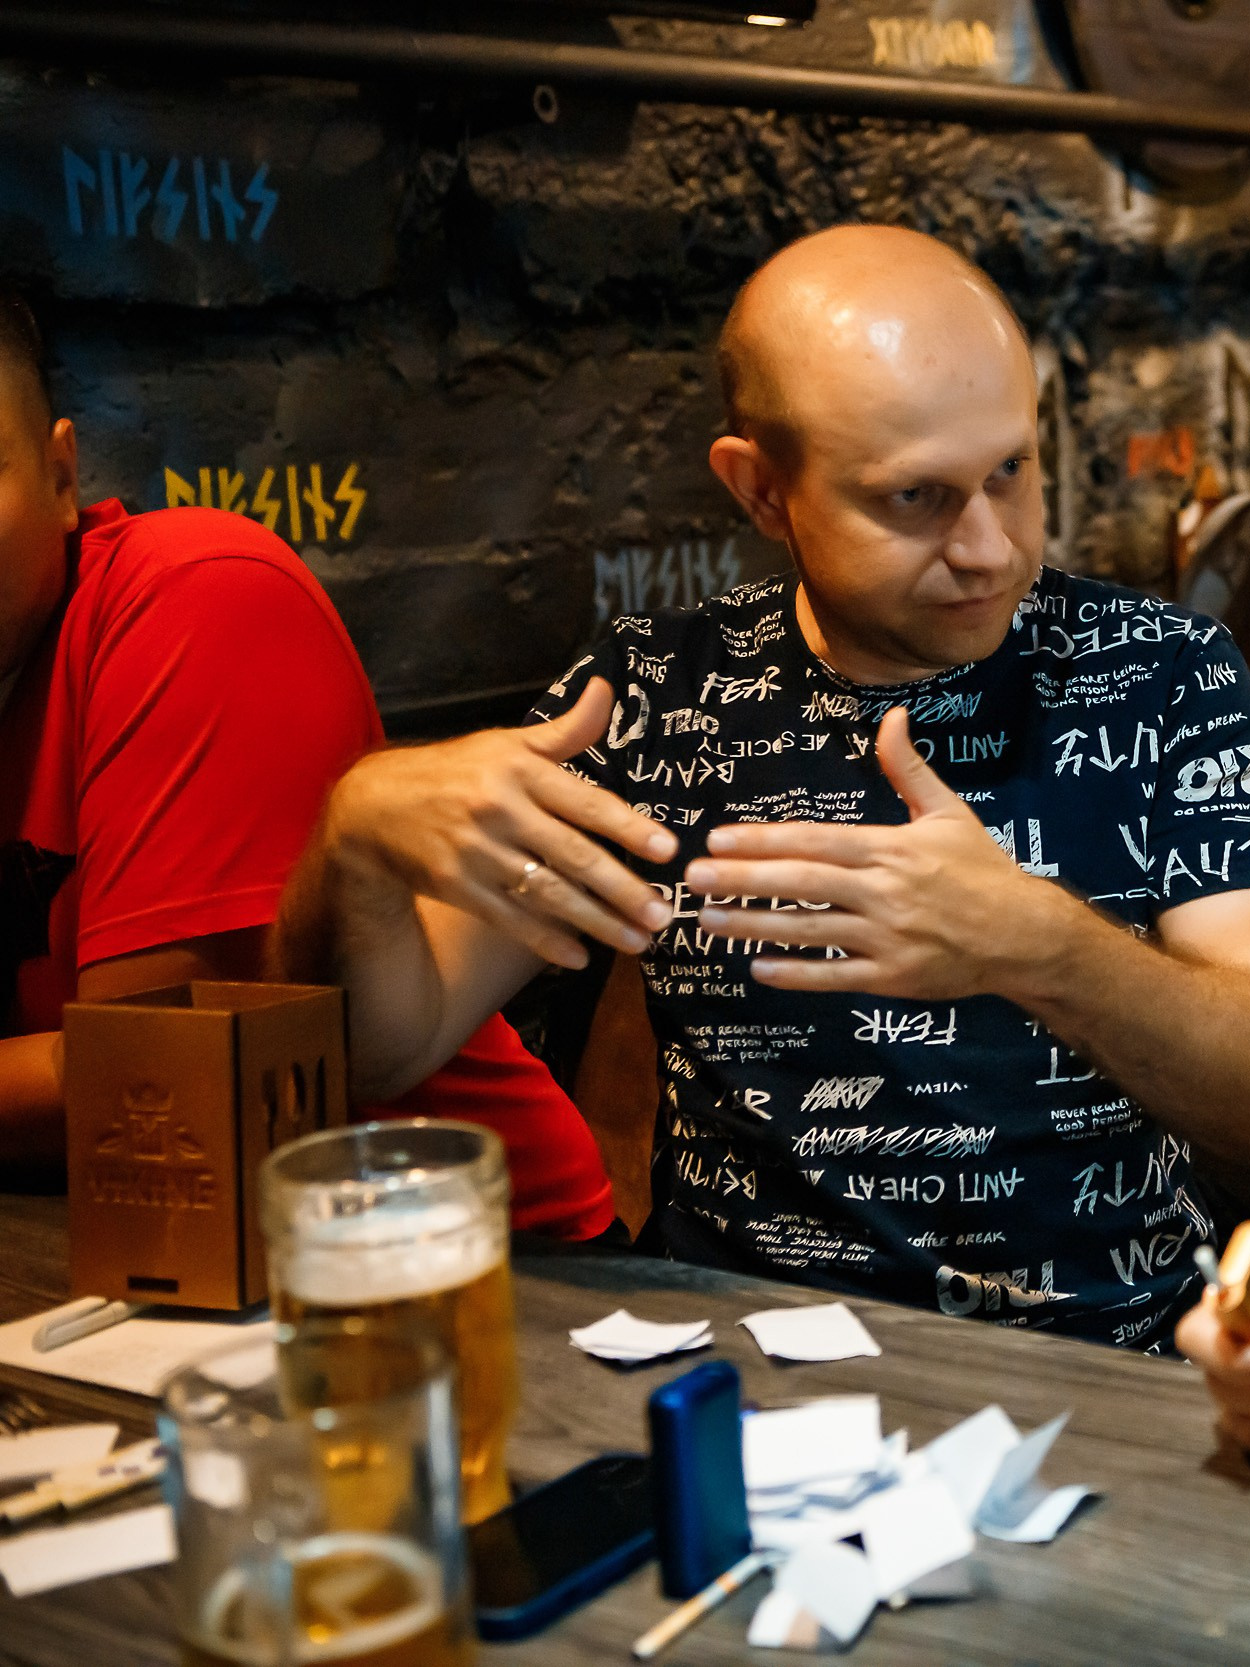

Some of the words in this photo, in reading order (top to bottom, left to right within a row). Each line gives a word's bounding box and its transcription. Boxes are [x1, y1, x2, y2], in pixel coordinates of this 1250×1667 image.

[1078, 597, 1173, 622] CHEAT
[1019, 614, 1218, 660] PERFECT
[699, 665, 782, 705] FEAR
[1033, 672, 1061, 687] NEVER
[1066, 673, 1110, 687] REGRET
[1153, 661, 1159, 669] A
[1195, 662, 1237, 692] ANTI
[1065, 684, 1109, 698] PERSON
[1117, 680, 1130, 689] TO
[661, 708, 720, 736] TRIO
[1207, 711, 1248, 731] BREAK
[697, 731, 796, 758] SOCIETY
[950, 731, 1011, 763] ANTI
[850, 790, 865, 799] DO
[957, 790, 995, 802] REAK
[1173, 807, 1194, 817] DO
[670, 964, 724, 979] LUNCH?
[678, 983, 694, 995] NO
[701, 982, 746, 998] SUCH
[806, 1026, 817, 1035] A
[850, 1007, 957, 1045] FEAR
[717, 1038, 762, 1053] PERSON
[785, 1039, 809, 1049] THE
[1050, 1107, 1088, 1120] NEVER
[1091, 1097, 1130, 1116] REGRET
[1055, 1119, 1085, 1132] GOOD
[1092, 1110, 1131, 1130] PERSON
[842, 1173, 946, 1205] CHEAT
[958, 1167, 1025, 1203] ANTI
[955, 1231, 1006, 1247] BREAK
